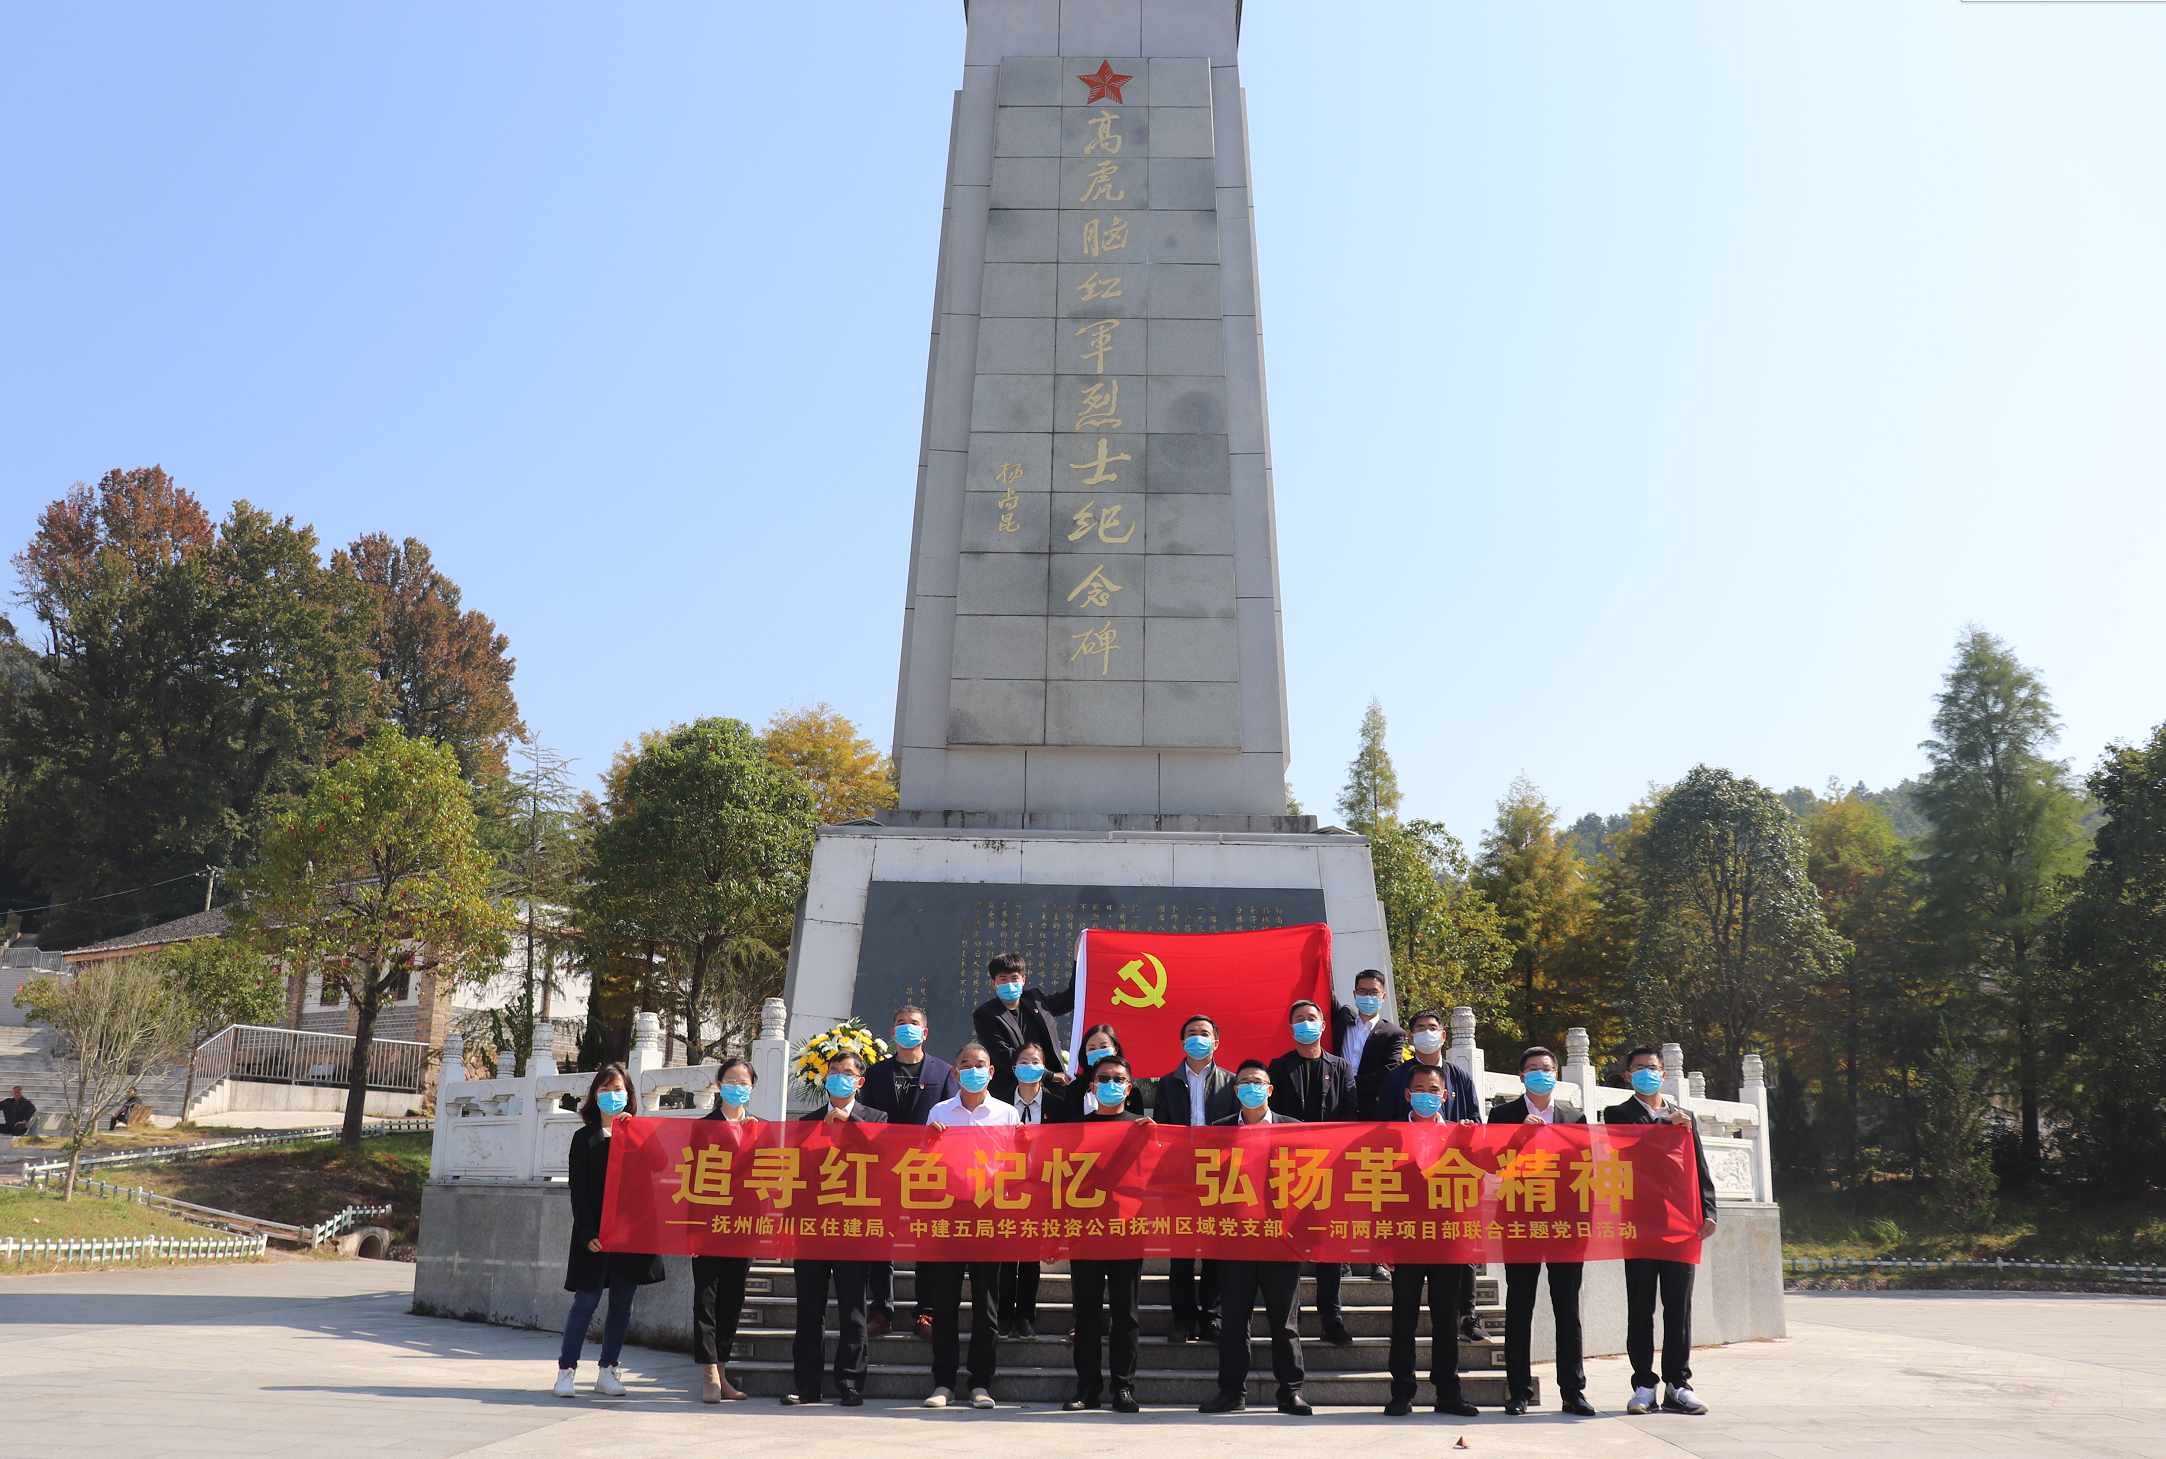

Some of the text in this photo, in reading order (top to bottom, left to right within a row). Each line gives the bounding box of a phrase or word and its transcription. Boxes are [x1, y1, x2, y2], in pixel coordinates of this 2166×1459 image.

[994, 461, 1025, 533] 杨尚昆
[671, 1144, 1634, 1213] 追寻红色记忆 弘扬革命精神
